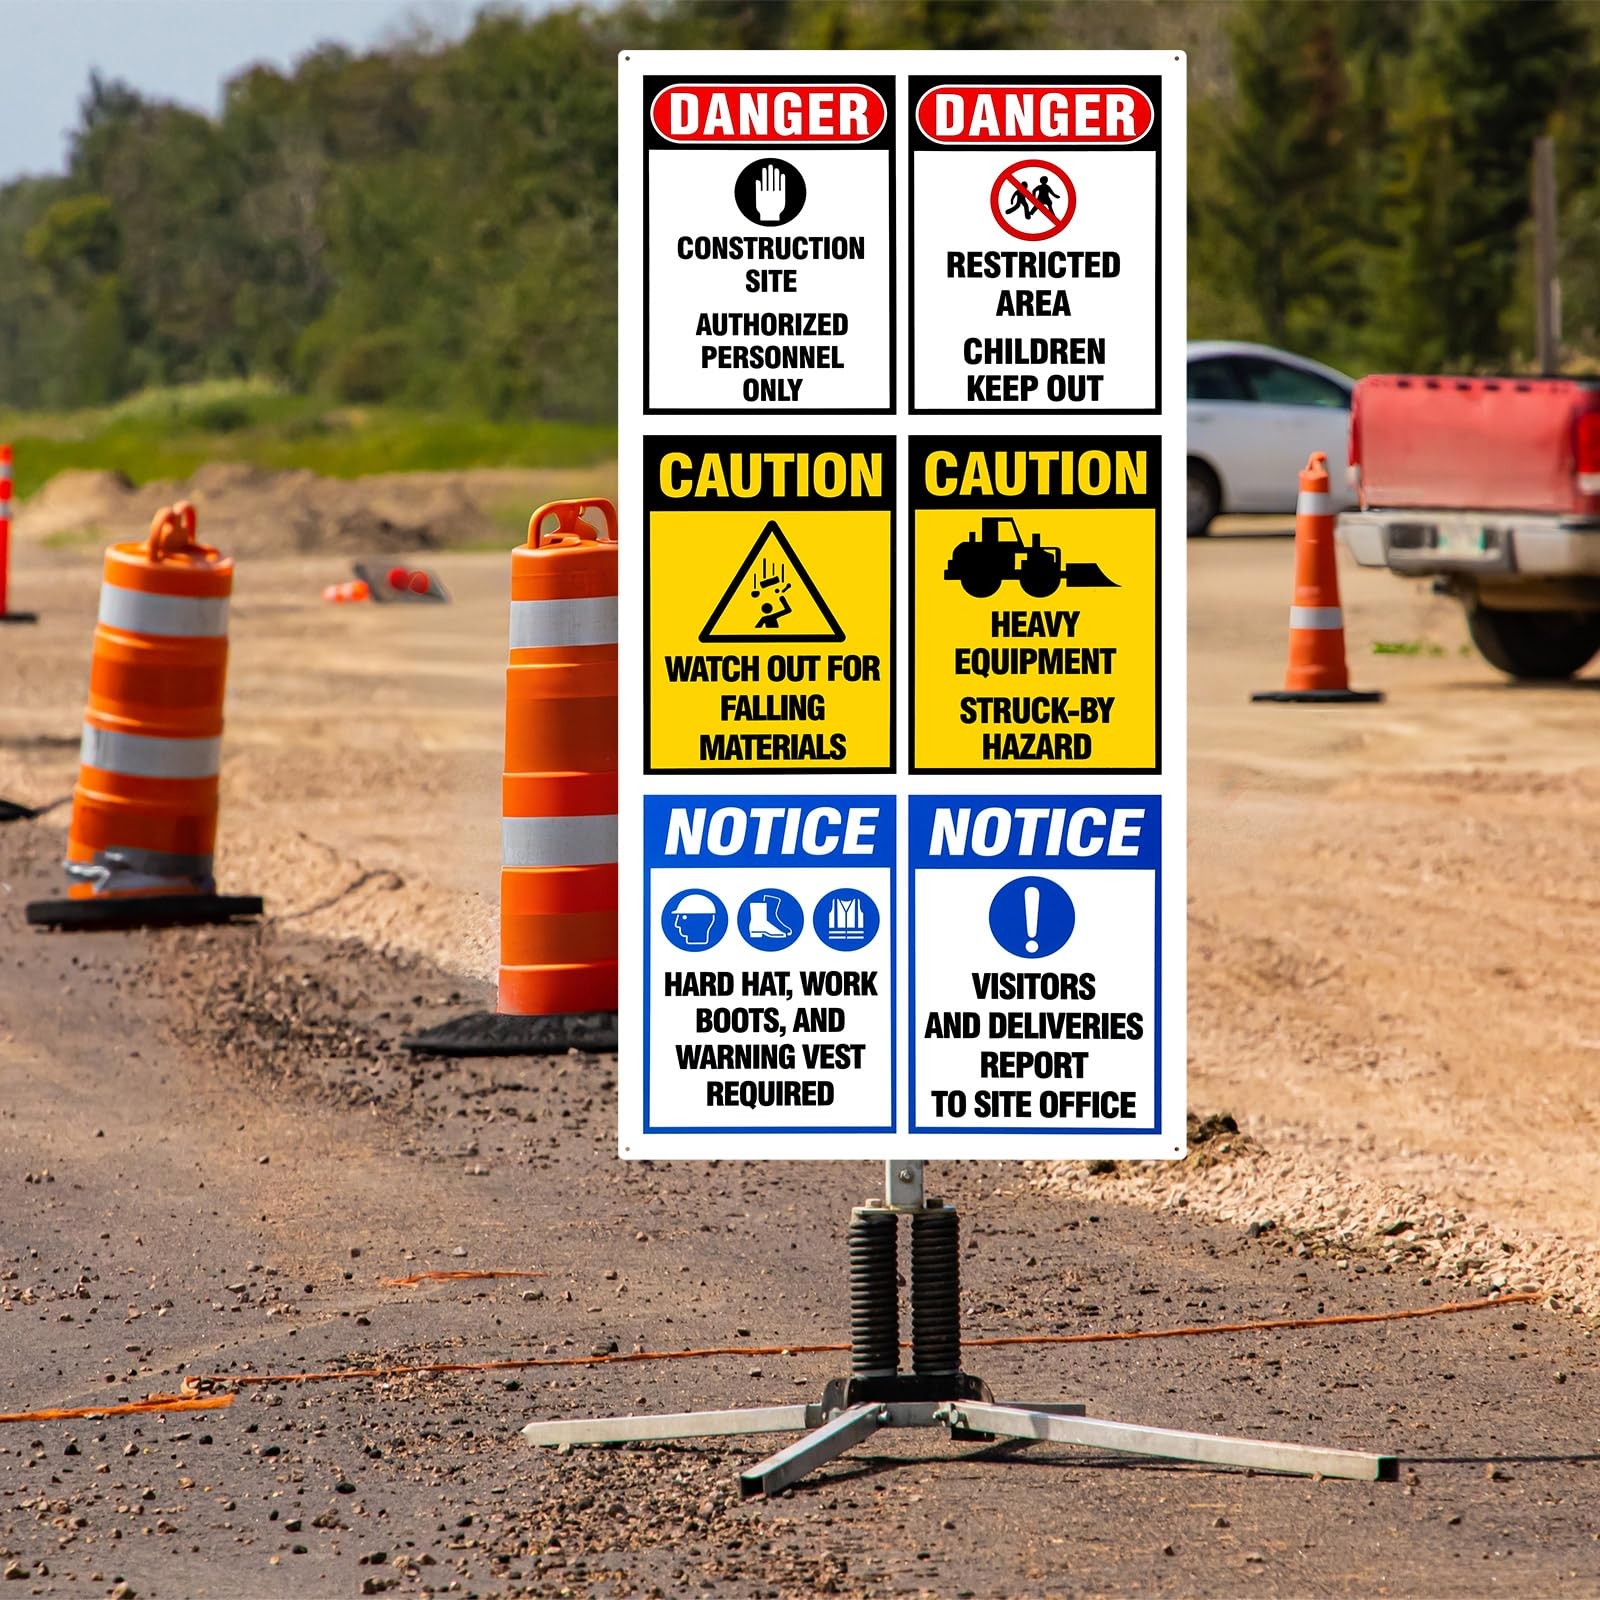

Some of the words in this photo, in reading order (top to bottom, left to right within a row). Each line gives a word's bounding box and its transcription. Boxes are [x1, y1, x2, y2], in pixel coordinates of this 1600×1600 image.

[670, 91, 870, 136] DANGER
[936, 92, 1137, 137] DANGER
[678, 237, 864, 259] CONSTRUCTION
[948, 251, 1120, 278] RESTRICTED
[746, 269, 796, 292] SITE
[996, 290, 1071, 316] AREA
[696, 313, 848, 336] AUTHORIZED
[702, 346, 844, 369] PERSONNEL
[964, 338, 1105, 364] CHILDREN
[744, 379, 803, 401] ONLY
[968, 375, 1038, 401] KEEP
[1047, 375, 1103, 401] OUT
[660, 452, 882, 498] CAUTION
[925, 450, 1146, 496] CAUTION
[992, 611, 1080, 637] HEAVY
[665, 655, 759, 682] WATCH
[768, 655, 821, 682] OUT
[828, 655, 880, 681] FOR
[956, 648, 1116, 678] EQUIPMENT
[721, 694, 825, 721] FALLING
[960, 697, 1115, 724] STRUCK-BY
[700, 733, 846, 760] MATERIALS
[983, 734, 1091, 759] HAZARD
[665, 807, 879, 855] NOTICE
[930, 808, 1145, 856] NOTICE
[665, 972, 734, 996] HARD
[742, 972, 792, 1000] HAT,
[800, 971, 877, 996] WORK
[972, 973, 1095, 1000] VISITORS
[697, 1008, 786, 1037] BOOTS,
[793, 1008, 844, 1032] AND
[925, 1012, 980, 1038] AND
[989, 1012, 1143, 1040] DELIVERIES
[676, 1044, 795, 1069] WARNING
[802, 1044, 865, 1069] VEST
[981, 1051, 1088, 1078] REPORT
[707, 1081, 834, 1109] REQUIRED
[931, 1090, 966, 1117] TO
[975, 1091, 1031, 1117] SITE
[1040, 1091, 1136, 1118] OFFICE
